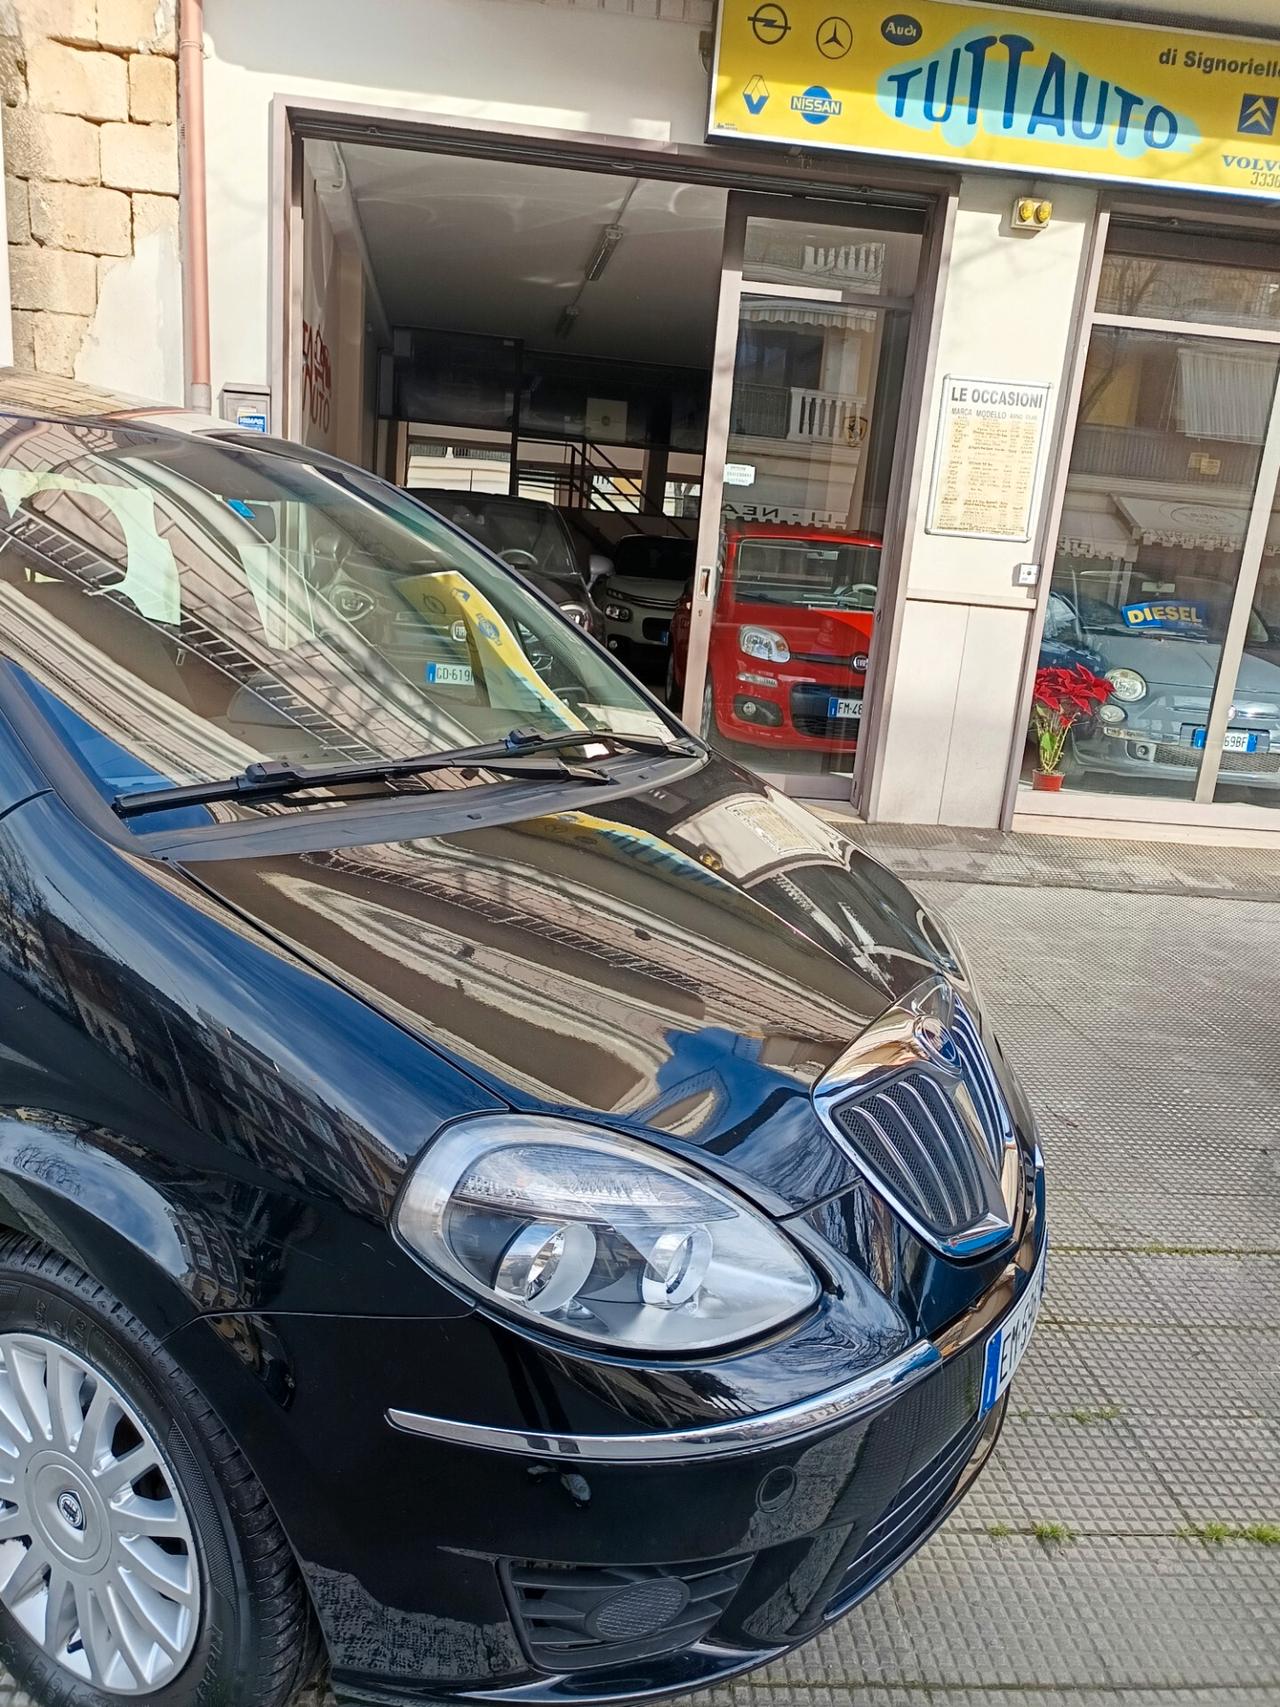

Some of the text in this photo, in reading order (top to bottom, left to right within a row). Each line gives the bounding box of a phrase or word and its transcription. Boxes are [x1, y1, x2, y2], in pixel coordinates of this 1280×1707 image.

[885, 22, 917, 37] Audi
[1159, 48, 1280, 78] di Signoriell
[887, 34, 1178, 150] TUTTAUTO
[792, 97, 841, 114] NISSAN
[1222, 154, 1280, 172] VOLV
[951, 387, 1043, 409] LE OCCASIONI
[952, 407, 973, 416] MARCA
[976, 409, 1007, 419] MODELLO
[1127, 606, 1203, 625] DIESEL
